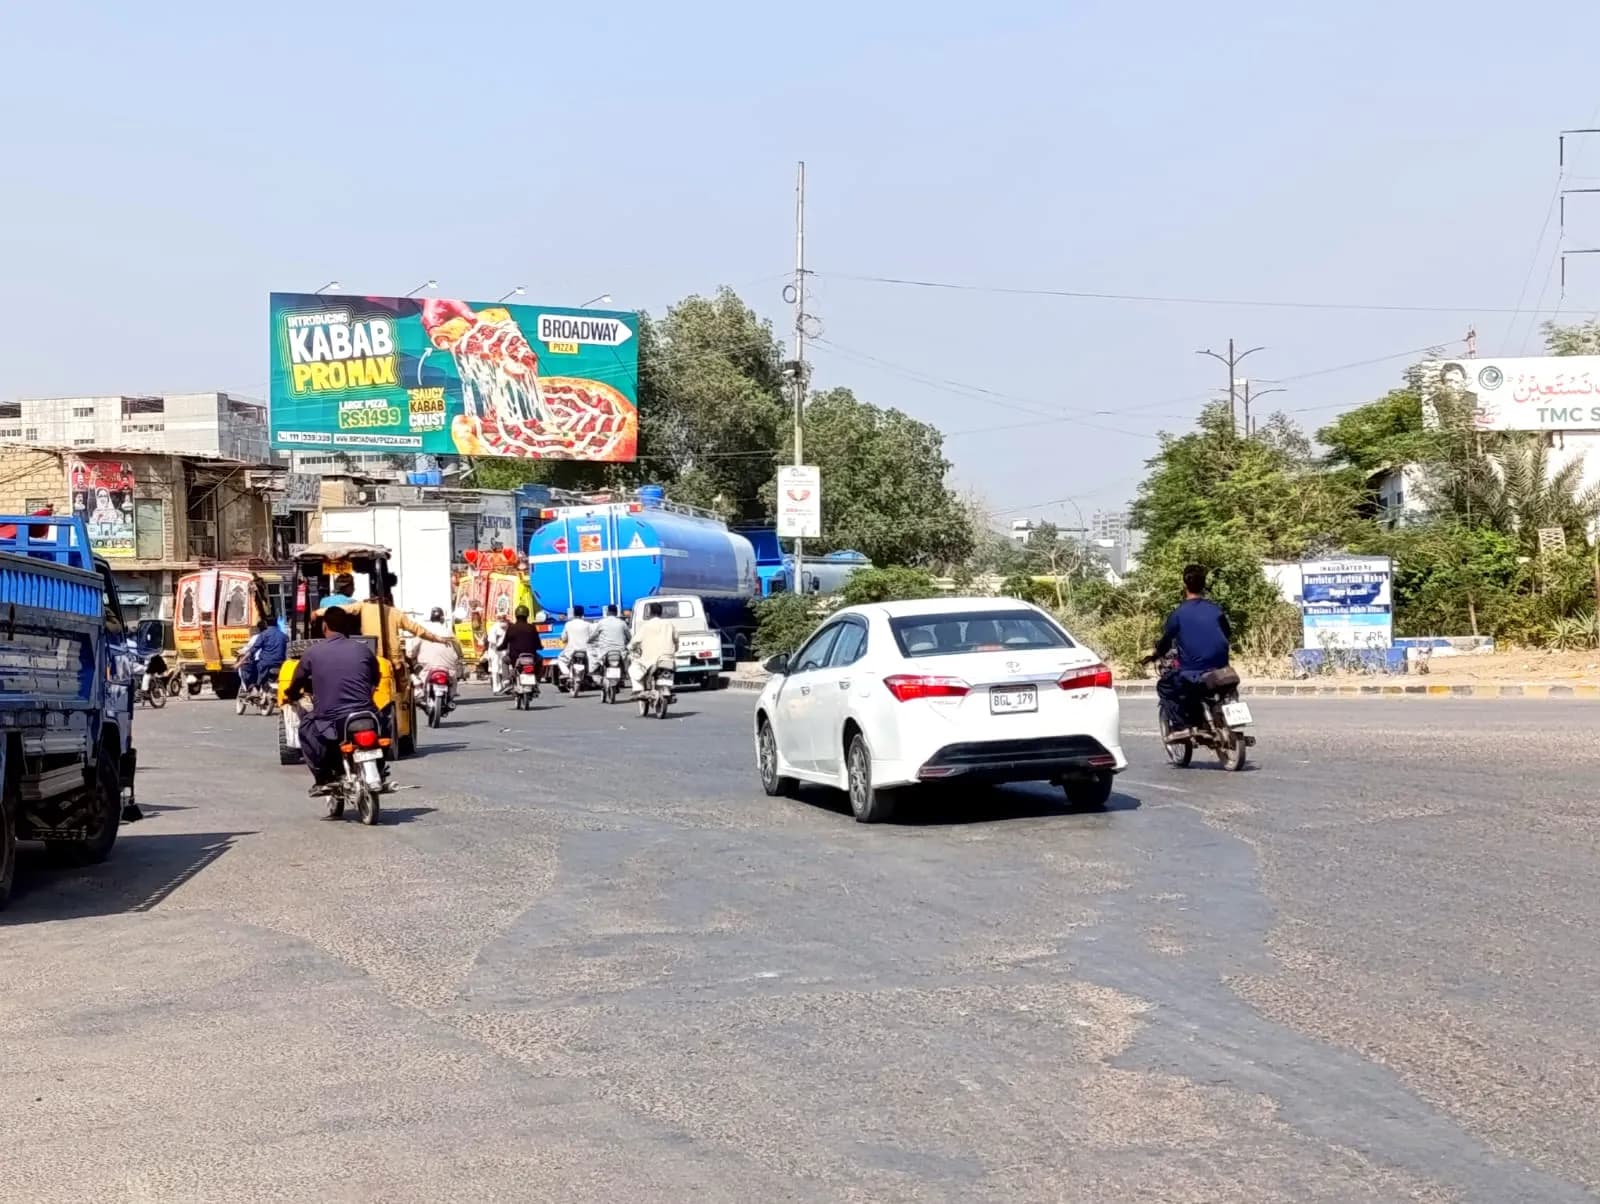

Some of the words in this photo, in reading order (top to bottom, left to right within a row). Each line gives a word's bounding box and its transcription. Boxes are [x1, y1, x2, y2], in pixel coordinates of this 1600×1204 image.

[542, 318, 620, 342] BROADWAY
[288, 320, 393, 363] KABAB
[553, 343, 575, 353] PIZZA
[339, 400, 365, 410] LARGE
[365, 399, 388, 409] PIZZA
[410, 400, 445, 413] KABAB
[409, 413, 446, 427] CRUST
[1536, 407, 1583, 423] TMC
[581, 559, 602, 570] SFS
[1016, 693, 1033, 705] 179
